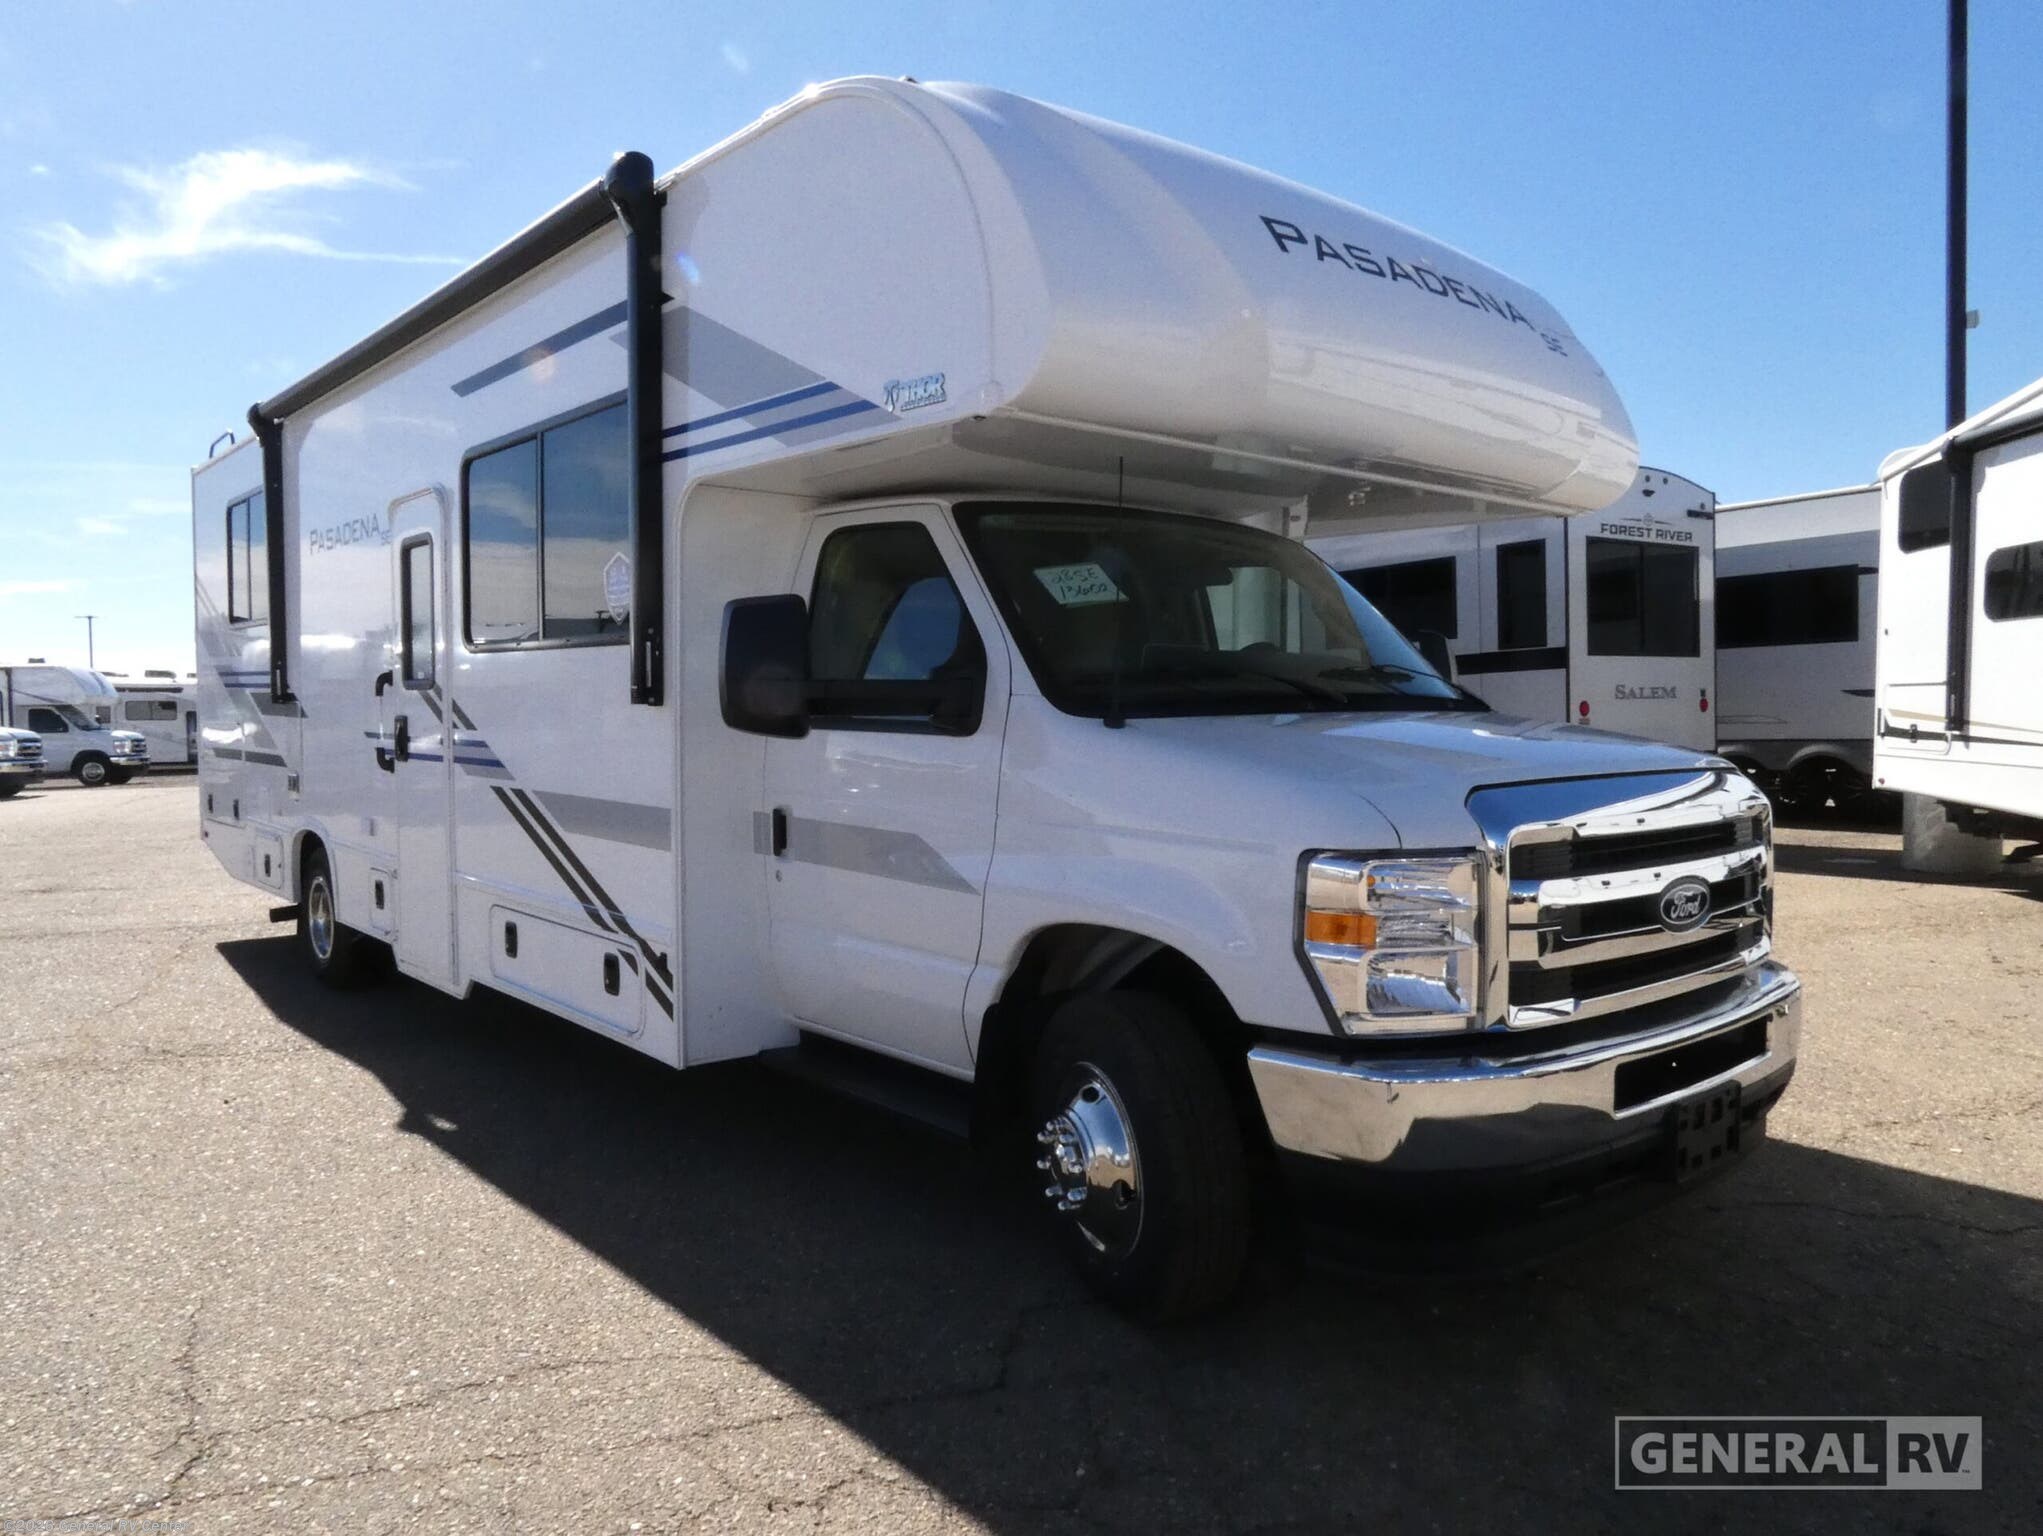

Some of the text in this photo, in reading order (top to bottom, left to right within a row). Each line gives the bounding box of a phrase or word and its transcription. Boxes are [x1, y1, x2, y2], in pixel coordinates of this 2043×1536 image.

[1258, 215, 1536, 331] PASADENA
[309, 513, 380, 556] PASADENA
[1600, 523, 1693, 543] FOREST RIVER
[1614, 684, 1677, 700] SALEM
[1670, 890, 1701, 919] Ford
